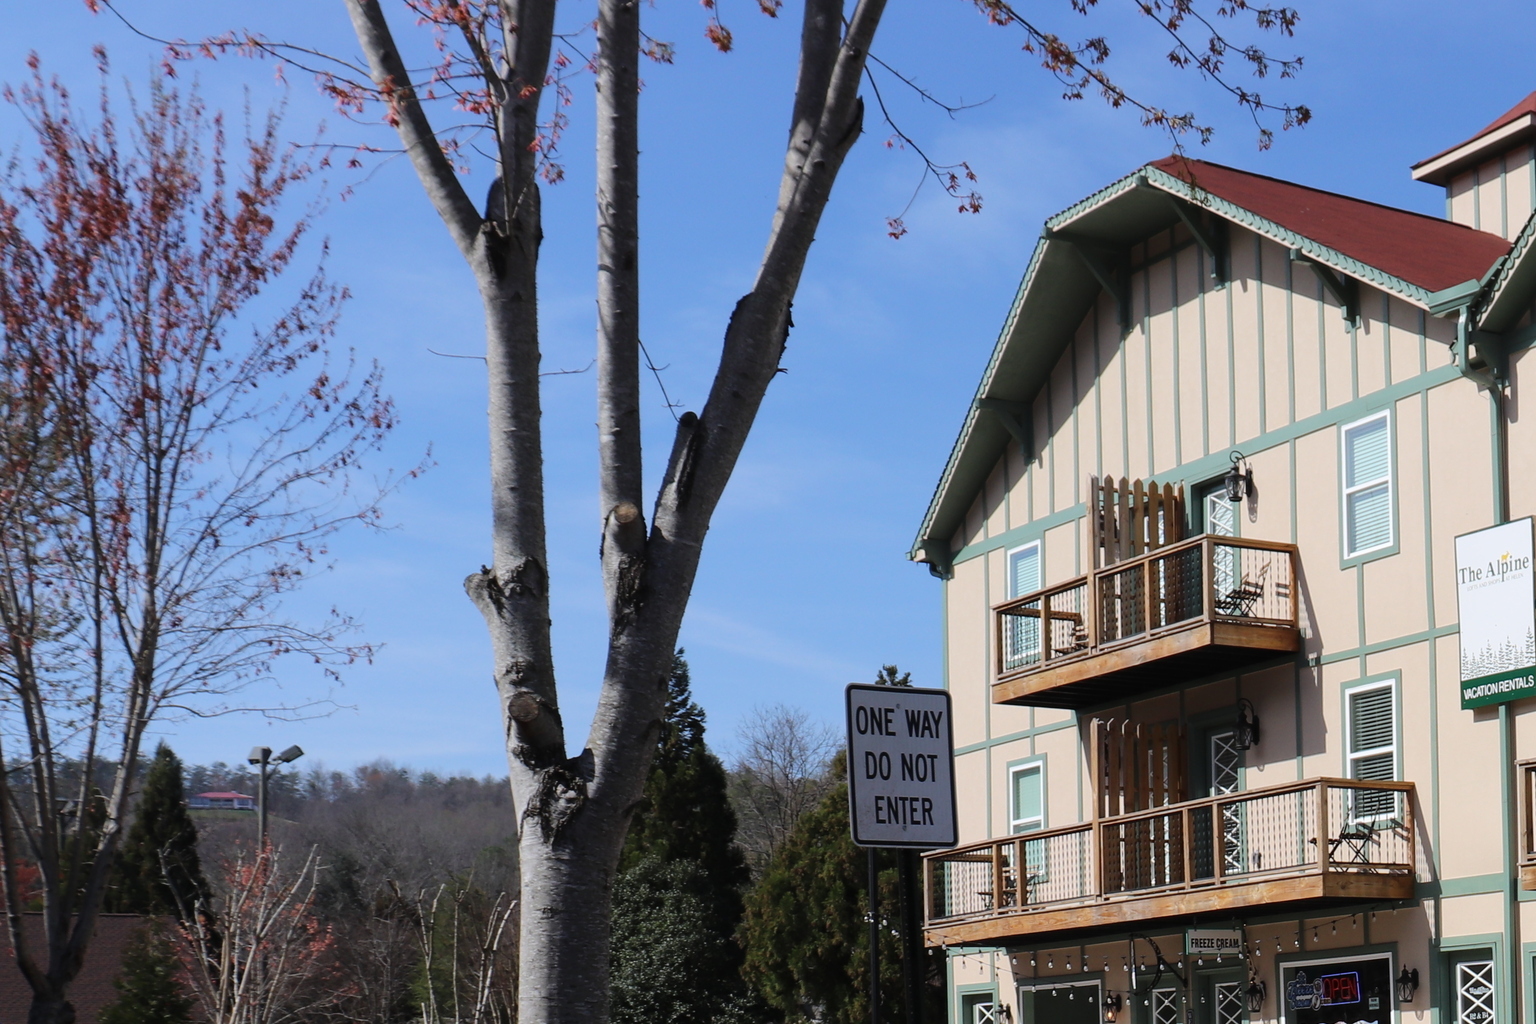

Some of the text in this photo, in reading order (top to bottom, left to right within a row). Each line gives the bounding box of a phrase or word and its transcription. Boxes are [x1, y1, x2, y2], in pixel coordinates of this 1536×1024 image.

[1459, 555, 1529, 584] The Alpine
[1463, 675, 1535, 700] VACATION RENTALS
[855, 705, 943, 739] ONE WAY
[865, 751, 938, 782] DO NOT
[874, 795, 934, 826] ENTER
[1191, 938, 1240, 949] FREEZE CREAM
[1322, 977, 1358, 1000] OPEN
